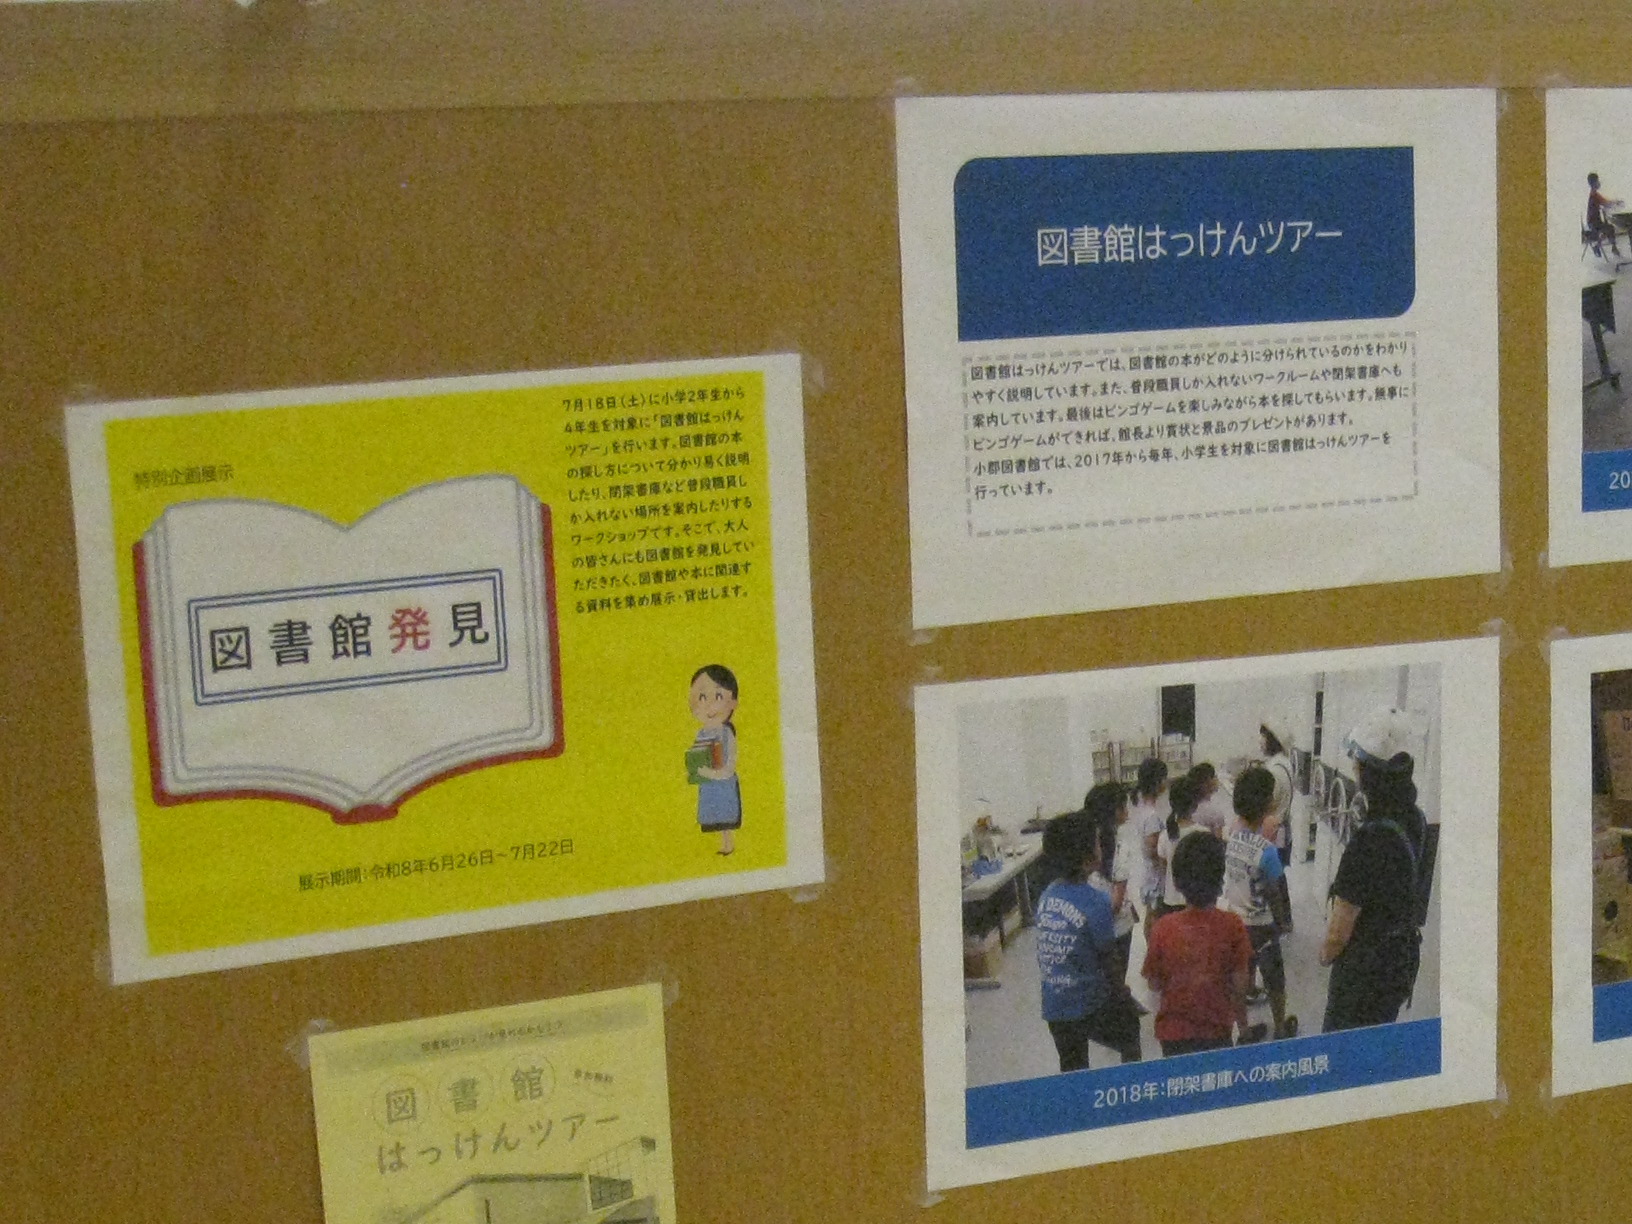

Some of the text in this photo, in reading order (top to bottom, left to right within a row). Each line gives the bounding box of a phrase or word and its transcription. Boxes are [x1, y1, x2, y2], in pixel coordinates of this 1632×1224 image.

[1036, 219, 1343, 267] 図書館はっけんツアー
[974, 480, 1053, 500] 行っています。
[209, 601, 490, 674] 図書館発見
[386, 1065, 544, 1124] 図書館
[1093, 1054, 1330, 1110] 2018年:閉架書庫への案内風景
[377, 1113, 621, 1175] はっけんツアー
